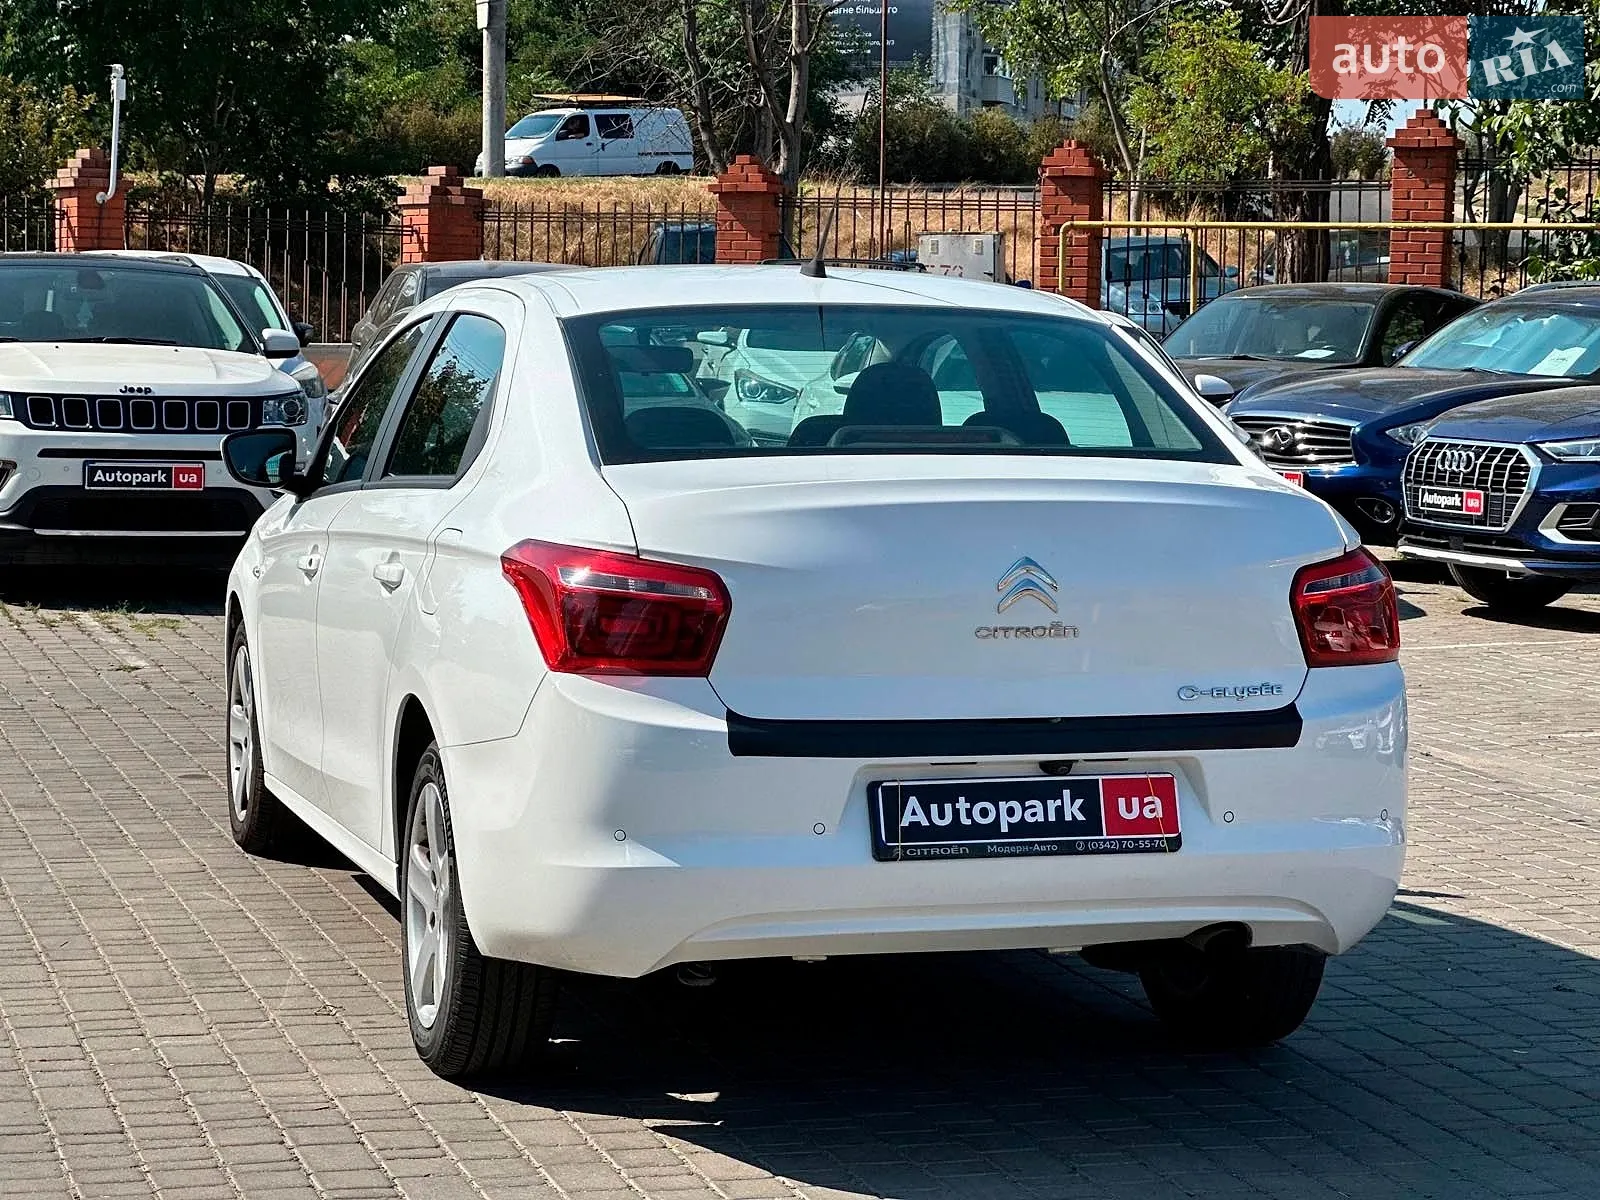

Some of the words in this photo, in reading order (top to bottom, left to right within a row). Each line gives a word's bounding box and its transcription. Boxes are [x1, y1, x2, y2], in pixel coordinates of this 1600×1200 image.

[856, 4, 898, 14] більшго
[119, 385, 153, 395] Jeep
[93, 469, 167, 485] Autopark
[179, 473, 197, 482] ua
[1422, 491, 1461, 508] Autopark
[1467, 498, 1480, 507] ua
[899, 789, 1086, 832] Autopark
[1117, 795, 1163, 820] ua
[987, 842, 1058, 854] Модерн-Авто
[1087, 840, 1119, 850] (0342)
[1121, 839, 1167, 849] 70-55-70
